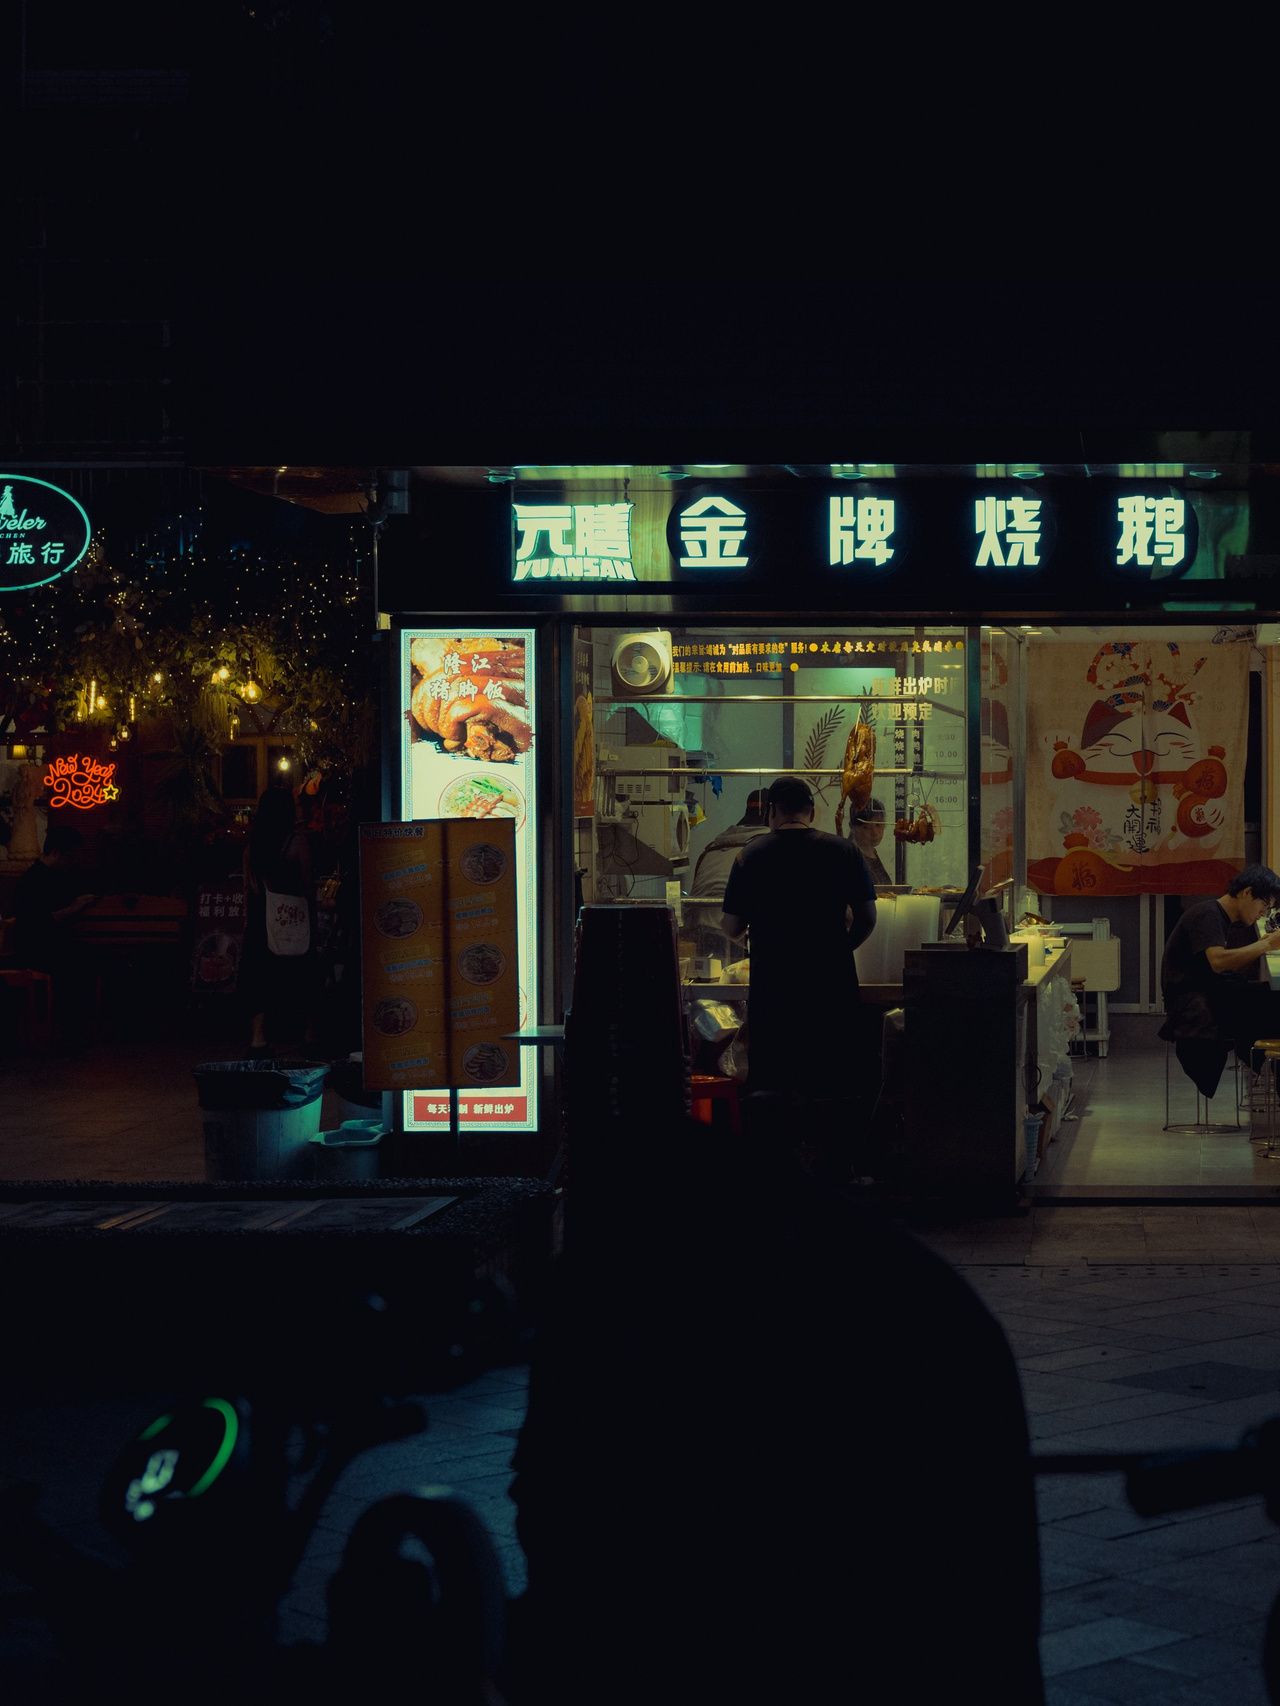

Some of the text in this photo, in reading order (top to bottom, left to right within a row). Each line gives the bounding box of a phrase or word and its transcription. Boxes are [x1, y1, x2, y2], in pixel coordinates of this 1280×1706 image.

[680, 496, 1186, 568] 金牌烧鹅
[5, 541, 66, 565] 旅行
[512, 556, 638, 581] YUANSAN
[443, 650, 492, 675] 隆江
[430, 678, 506, 702] 猪脚饭
[872, 702, 933, 721] 欢迎预定
[43, 753, 116, 786] New Year
[50, 777, 107, 810] 2024
[935, 796, 958, 804] 16:00
[362, 826, 425, 839] 每日特价快餐
